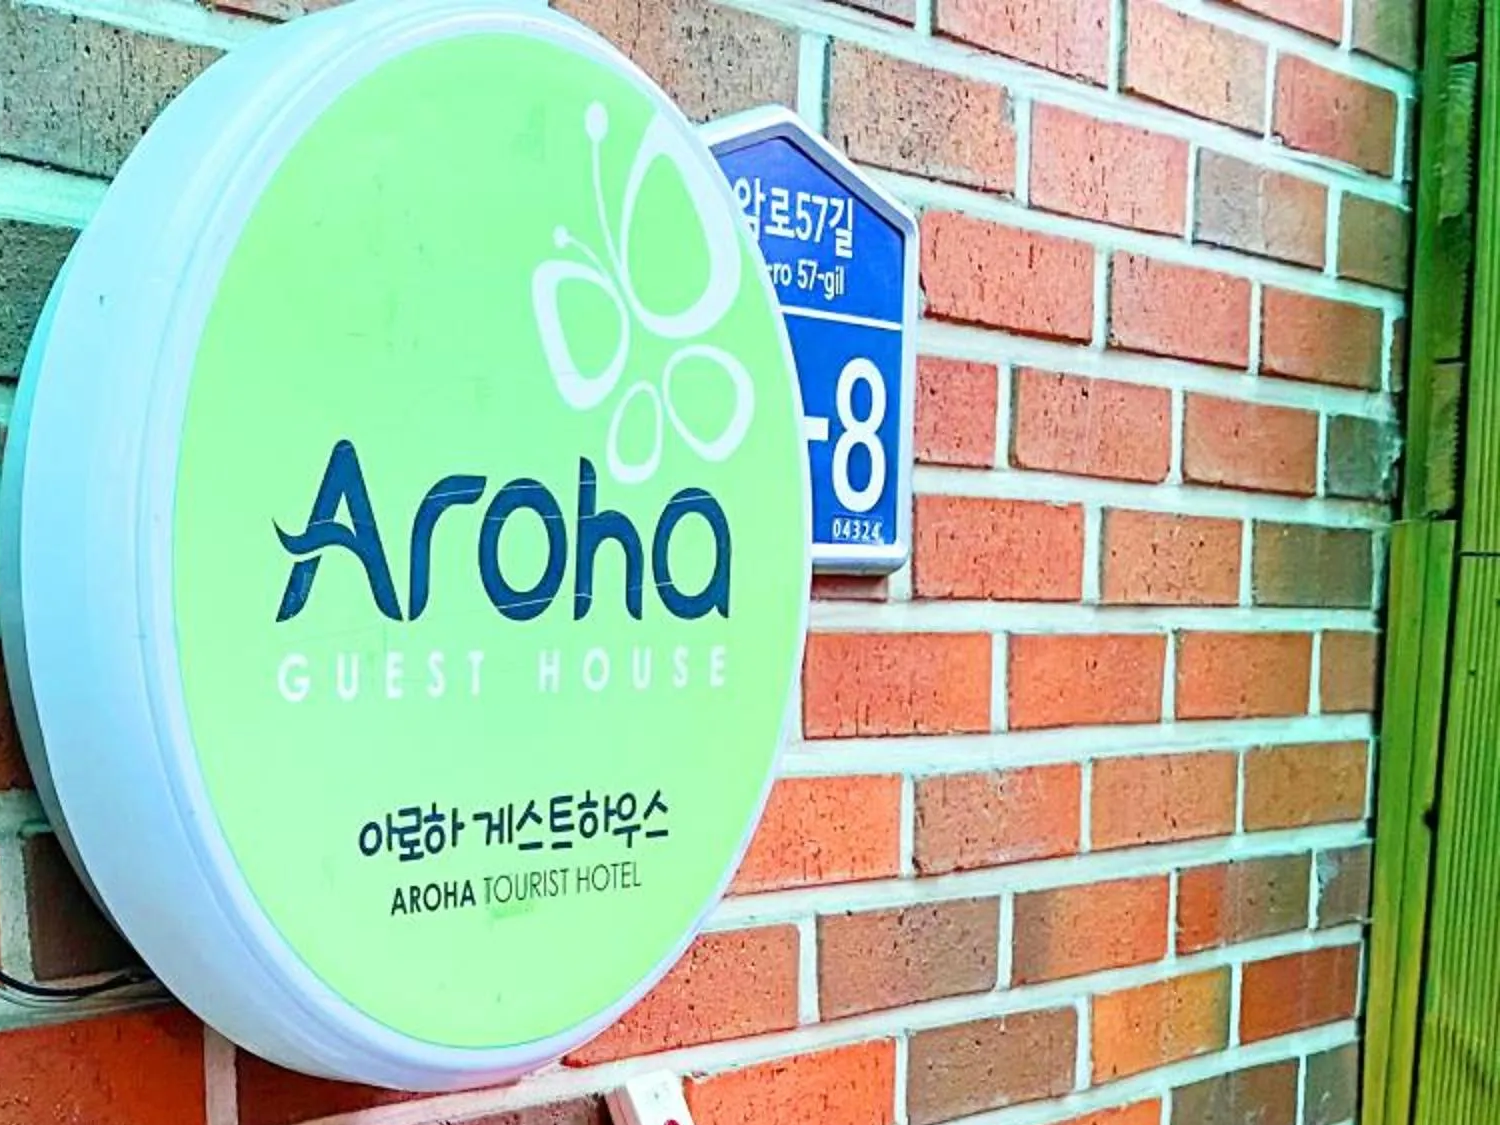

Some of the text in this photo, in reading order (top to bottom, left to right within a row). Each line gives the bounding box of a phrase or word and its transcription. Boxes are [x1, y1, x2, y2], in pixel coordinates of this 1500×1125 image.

[797, 259, 845, 301] 57-gil
[271, 438, 733, 623] Aroha
[832, 517, 883, 542] 04324
[277, 645, 728, 702] GUEST HOUSE
[358, 789, 670, 863] 아로하 게스트하우스
[390, 861, 643, 917] AROHA TOURIST HOTEL
